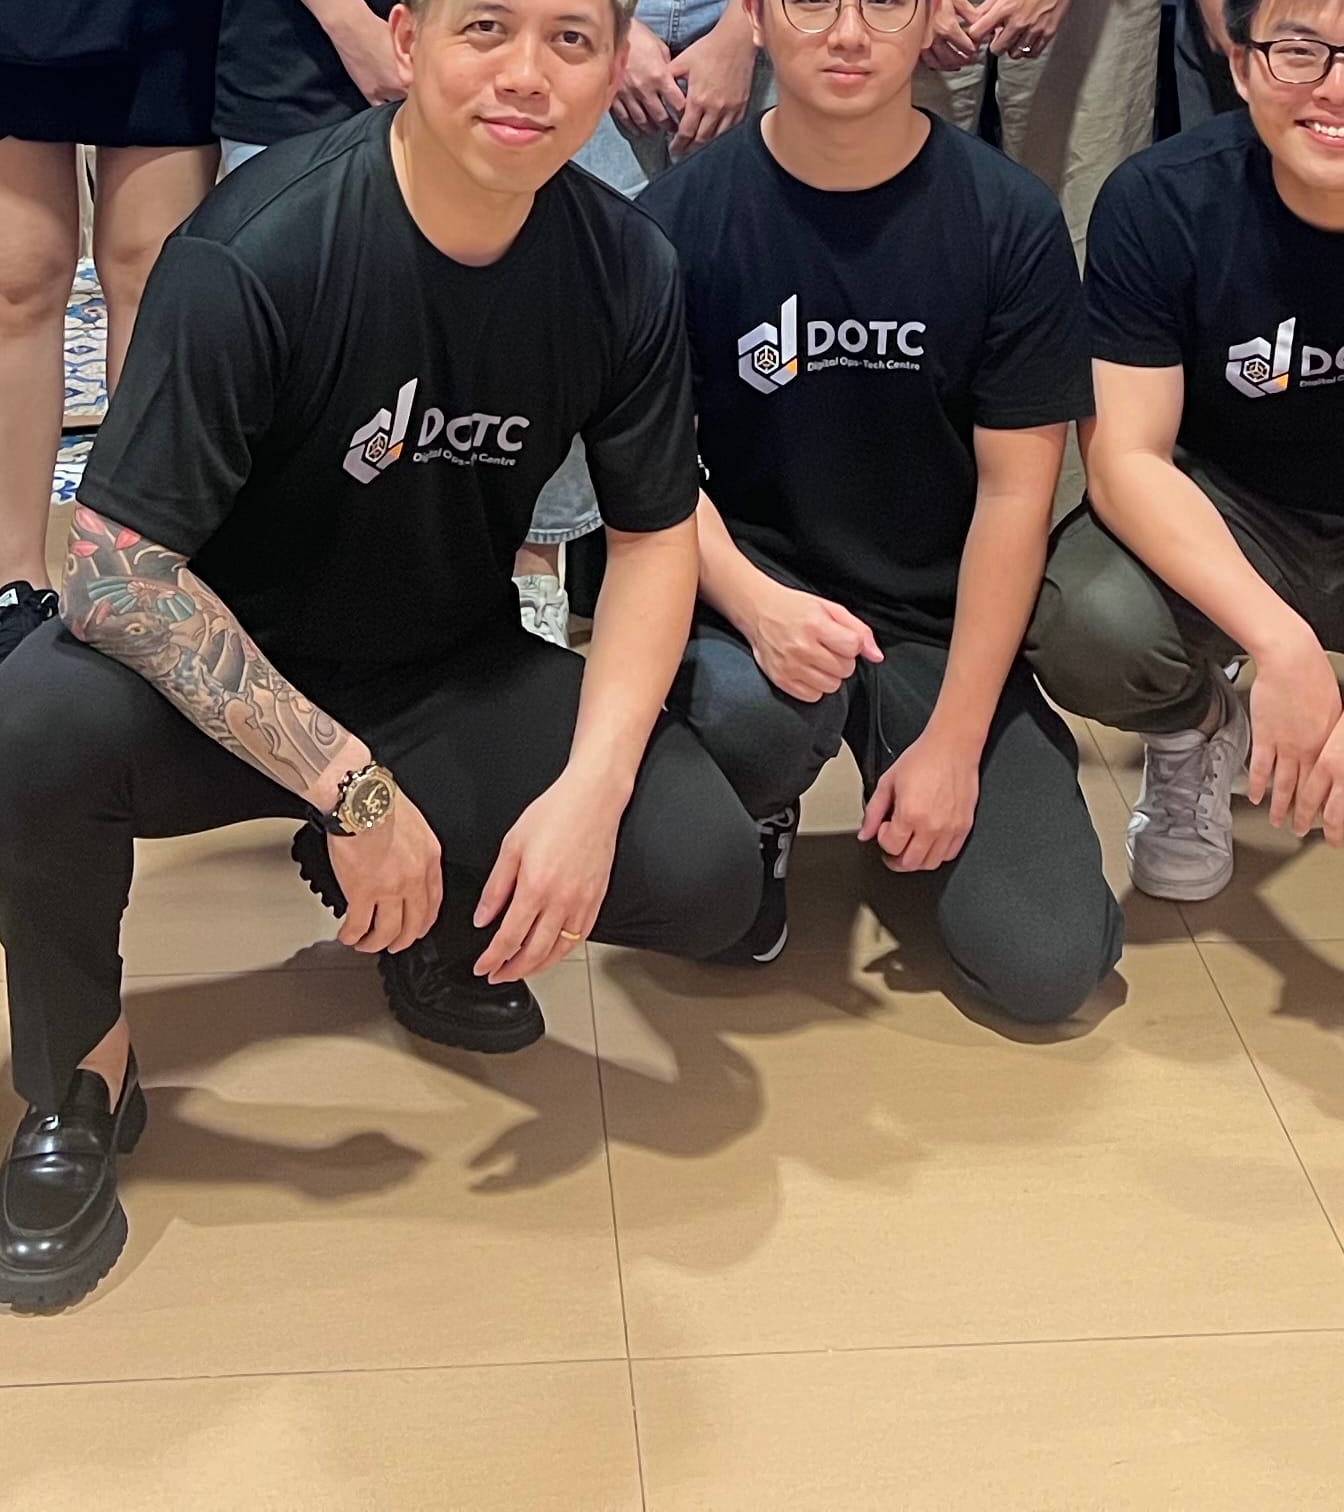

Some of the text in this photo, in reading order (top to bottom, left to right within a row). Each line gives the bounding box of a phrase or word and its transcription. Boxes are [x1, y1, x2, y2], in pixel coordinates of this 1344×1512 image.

[807, 319, 927, 357] DOTC
[807, 356, 920, 371] Digital Ops-Tech Centre
